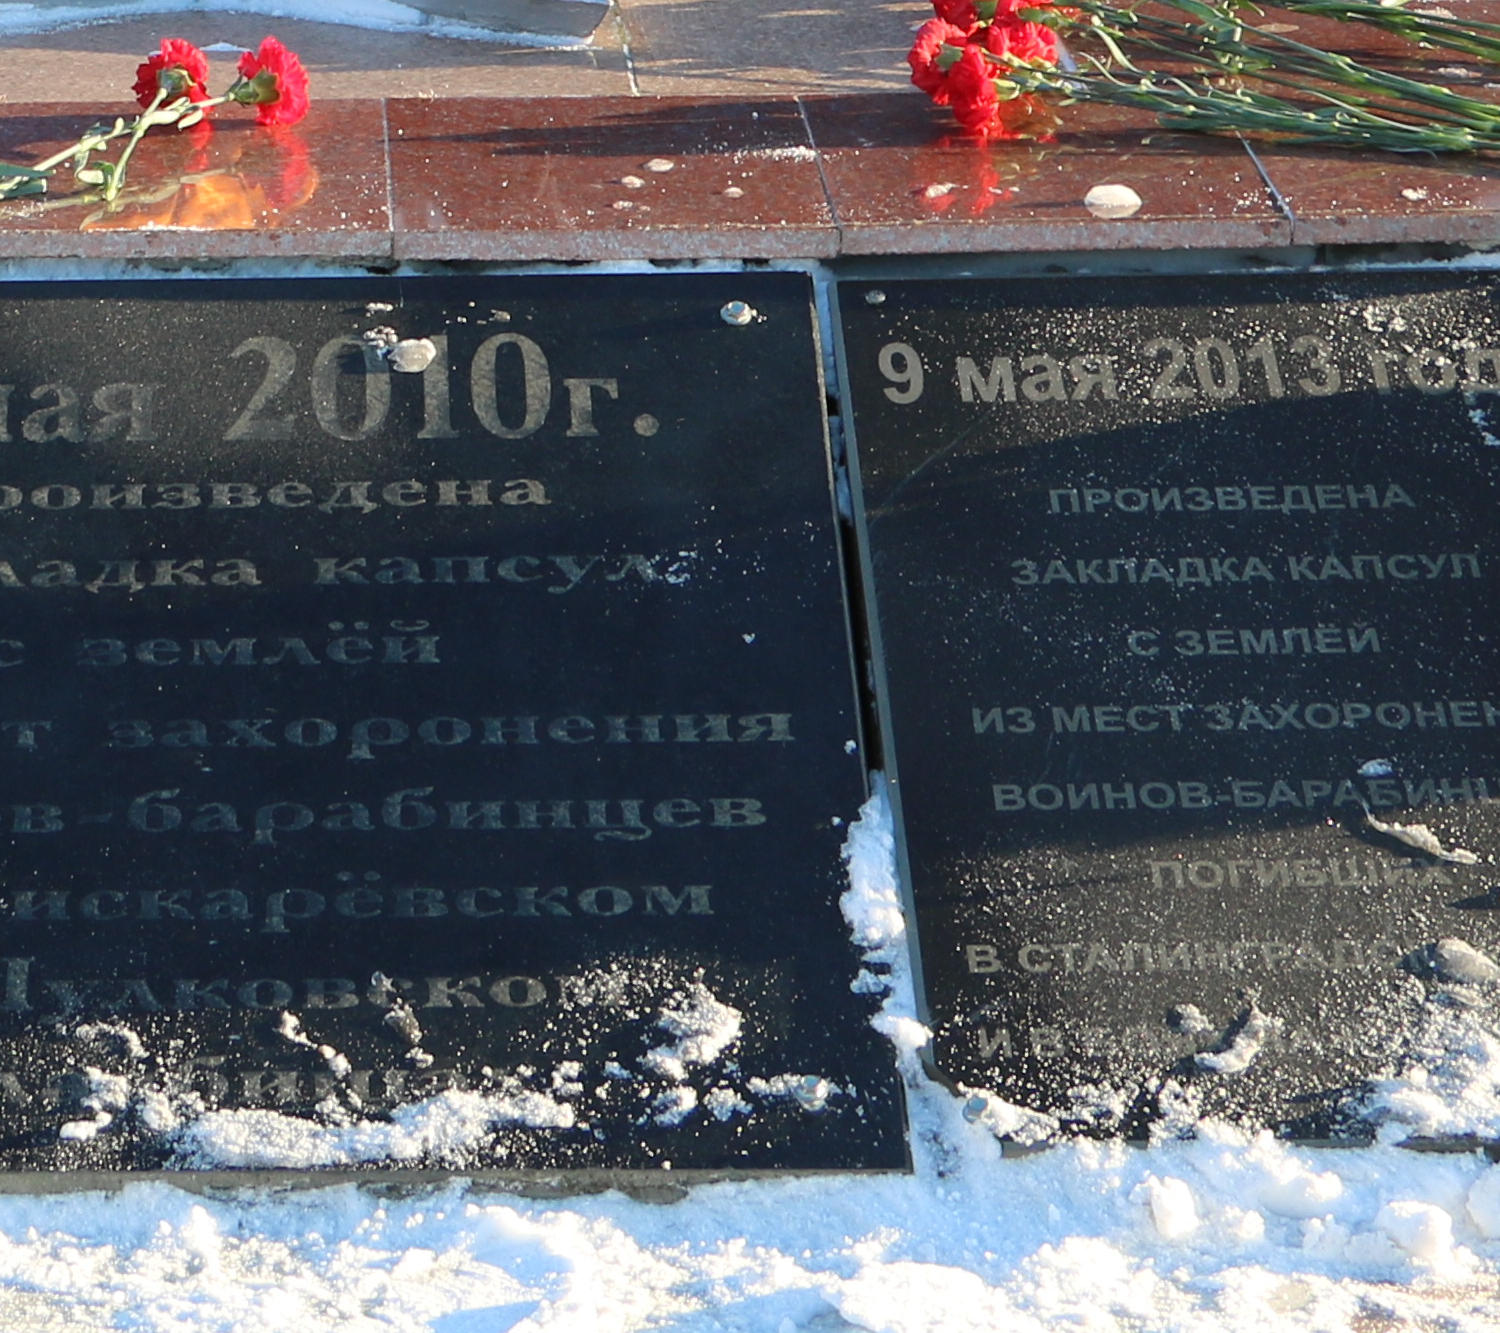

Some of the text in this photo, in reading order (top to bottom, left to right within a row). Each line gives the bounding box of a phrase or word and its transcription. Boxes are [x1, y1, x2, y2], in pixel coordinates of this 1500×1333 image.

[222, 331, 661, 443] 2010г.
[877, 342, 925, 405] 9
[956, 349, 1120, 403] мая
[1143, 334, 1343, 401] 2013
[1047, 482, 1418, 516] ПРОИЗВЕДЕНА
[312, 552, 668, 596] капсул
[1010, 552, 1484, 587] ЗАКЛАДКА КАПСУЛ
[76, 616, 443, 669] землёй
[1126, 621, 1382, 658] С ЗЕМЛЁЙ
[108, 707, 798, 761] захоронения
[971, 706, 1036, 735] ИЗ
[1051, 702, 1188, 735] МЕСТ
[1148, 856, 1455, 891] ПОГИБШИХ
[965, 943, 1003, 975] В
